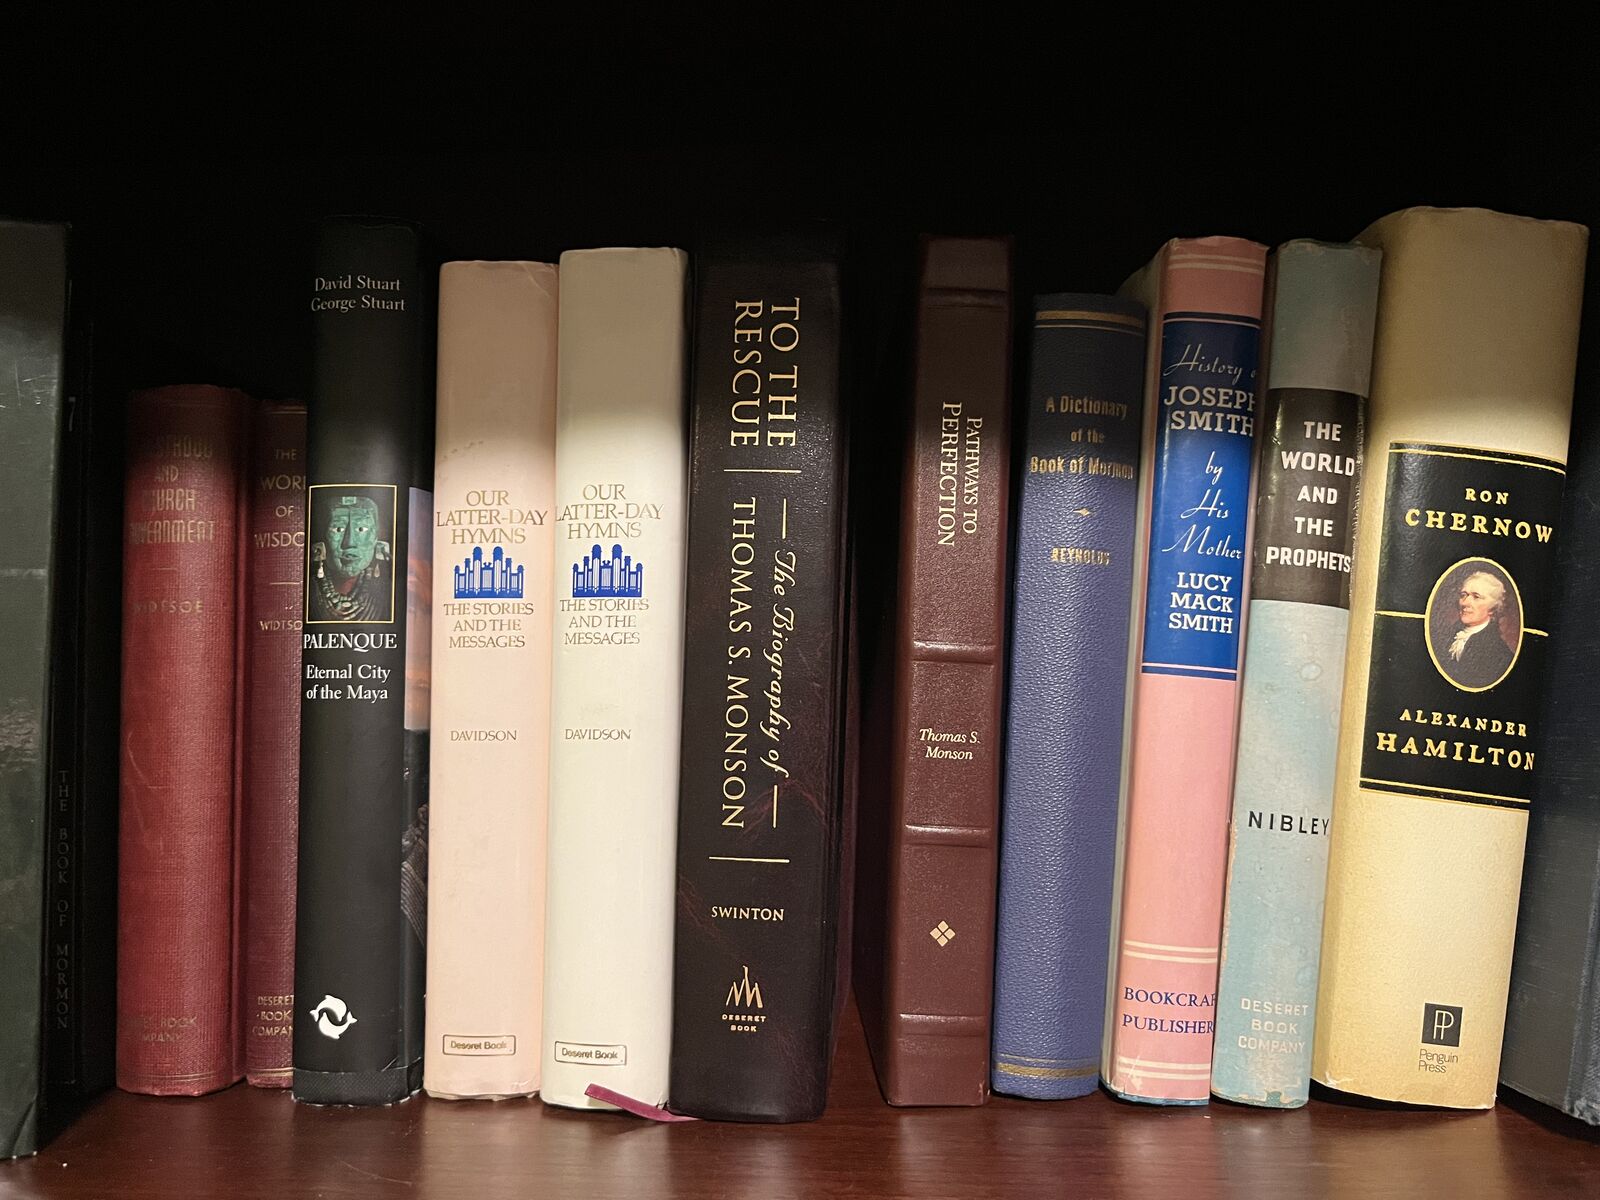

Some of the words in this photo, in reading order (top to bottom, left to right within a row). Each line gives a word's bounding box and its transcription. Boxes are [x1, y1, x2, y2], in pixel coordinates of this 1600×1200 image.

[315, 275, 352, 291] David
[356, 275, 400, 291] Stuart
[311, 297, 356, 313] George
[361, 295, 405, 311] Stuart
[769, 297, 800, 352] TO
[730, 299, 763, 447] RESCUE
[1163, 343, 1243, 386] History
[767, 365, 798, 447] THE
[1046, 398, 1055, 413] A
[1059, 395, 1128, 420] Dictionary
[1171, 410, 1254, 437] SMITH
[1303, 421, 1342, 442] THE
[1070, 428, 1083, 442] of
[1087, 428, 1105, 444] the
[273, 448, 297, 461] THE
[963, 417, 983, 505] PATHWAYS
[1281, 451, 1355, 476] WORLD
[937, 402, 962, 547] PERFECTION
[1030, 455, 1064, 473] Book
[1070, 455, 1085, 473] of
[1088, 457, 1134, 480] Mormon
[1205, 451, 1223, 485] by
[260, 474, 306, 490] WOR
[466, 490, 510, 506] OUR
[582, 484, 626, 500] OUR
[1297, 485, 1338, 505] AND
[1465, 488, 1509, 505] RON
[275, 505, 295, 518] OF
[555, 503, 664, 521] LATTER-DAY
[1180, 488, 1229, 519] His
[436, 508, 548, 527] LATTER-DAY
[962, 509, 978, 534] TO
[1294, 516, 1334, 537] THE
[1405, 508, 1553, 544] CHERNOW
[451, 527, 527, 544] HYMNS
[567, 521, 642, 539] HYMNS
[253, 532, 305, 548] WISDO
[1162, 524, 1243, 560] Mother
[728, 497, 756, 633] THOMAS
[1050, 547, 1110, 565] REYNOLDS
[1265, 546, 1352, 573] PROPHETS
[772, 550, 796, 597] The
[1176, 572, 1232, 592] LUCY
[443, 603, 471, 616] THE
[473, 602, 534, 616] STORIES
[560, 599, 586, 612] THE
[589, 599, 650, 612] STORIES
[1170, 592, 1234, 613] MACK
[260, 619, 303, 631] WIDTSO
[453, 619, 487, 632] AND
[489, 619, 522, 632] THE
[568, 615, 602, 628] AND
[604, 615, 636, 628] THE
[1168, 612, 1233, 634] SMITH
[303, 633, 398, 652] PALENQUE
[449, 635, 525, 649] MESSAGES
[564, 632, 640, 645] MESSAGES
[727, 646, 751, 666] S.
[306, 664, 353, 679] Eternal
[357, 664, 391, 683] City
[760, 604, 795, 742] Biography
[306, 684, 319, 699] of
[320, 684, 342, 699] the
[346, 685, 388, 704] Maya
[1399, 708, 1527, 737] ALEXANDER
[450, 730, 517, 741] DAVIDSON
[564, 728, 631, 741] DAVIDSON
[919, 728, 967, 743] Thomas
[969, 731, 981, 744] S.
[721, 674, 750, 829] MONSON
[925, 746, 973, 760] Monson
[1376, 732, 1535, 771] HAMILTON
[760, 749, 790, 778] of
[57, 770, 70, 812] THE
[1248, 810, 1330, 836] NIBLEY
[56, 828, 70, 884] BOOK
[56, 900, 70, 927] OF
[711, 906, 785, 921] SWINTON
[56, 943, 70, 1030] MORMON
[257, 995, 294, 1006] DESERET
[1240, 998, 1309, 1017] DESERET
[721, 1014, 767, 1022] DESERET
[1251, 1018, 1298, 1034] BOOK
[730, 1024, 757, 1032] BOOK
[450, 1040, 482, 1050] Deseret
[484, 1041, 507, 1050] Book
[561, 1047, 593, 1058] Deseret
[595, 1050, 618, 1059] Book
[1238, 1035, 1305, 1053] COMPANY
[1419, 1048, 1459, 1064] Penguin
[1418, 1060, 1447, 1074] Press
